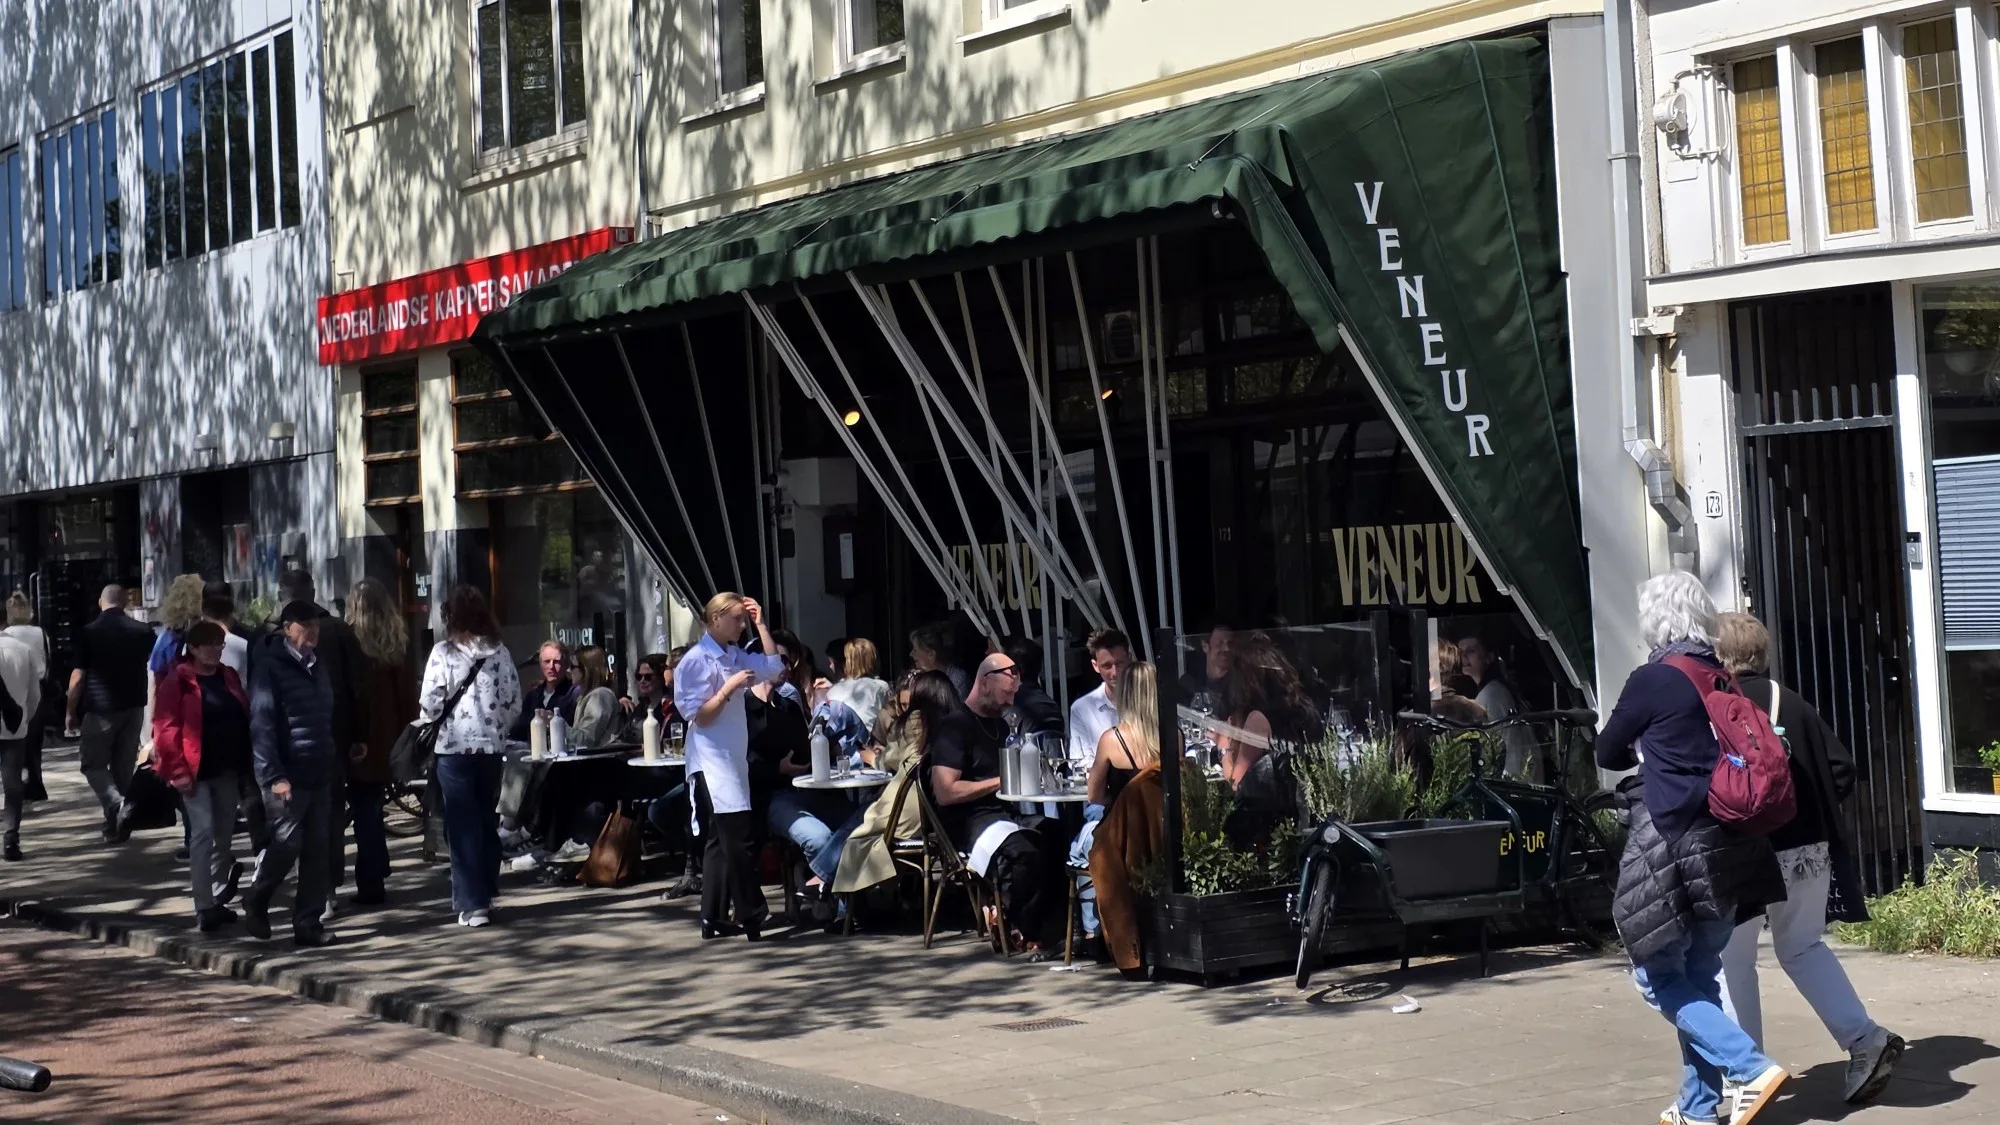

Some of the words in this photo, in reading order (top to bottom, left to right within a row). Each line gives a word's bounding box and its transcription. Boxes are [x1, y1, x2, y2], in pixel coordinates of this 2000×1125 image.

[321, 295, 430, 345] NEDERLANDSE
[434, 260, 580, 321] KAPPERSAKA
[1354, 181, 1495, 457] VENEUR
[1705, 495, 1721, 514] 173
[1332, 522, 1482, 606] VENEUR
[1500, 830, 1545, 856] ENUR
